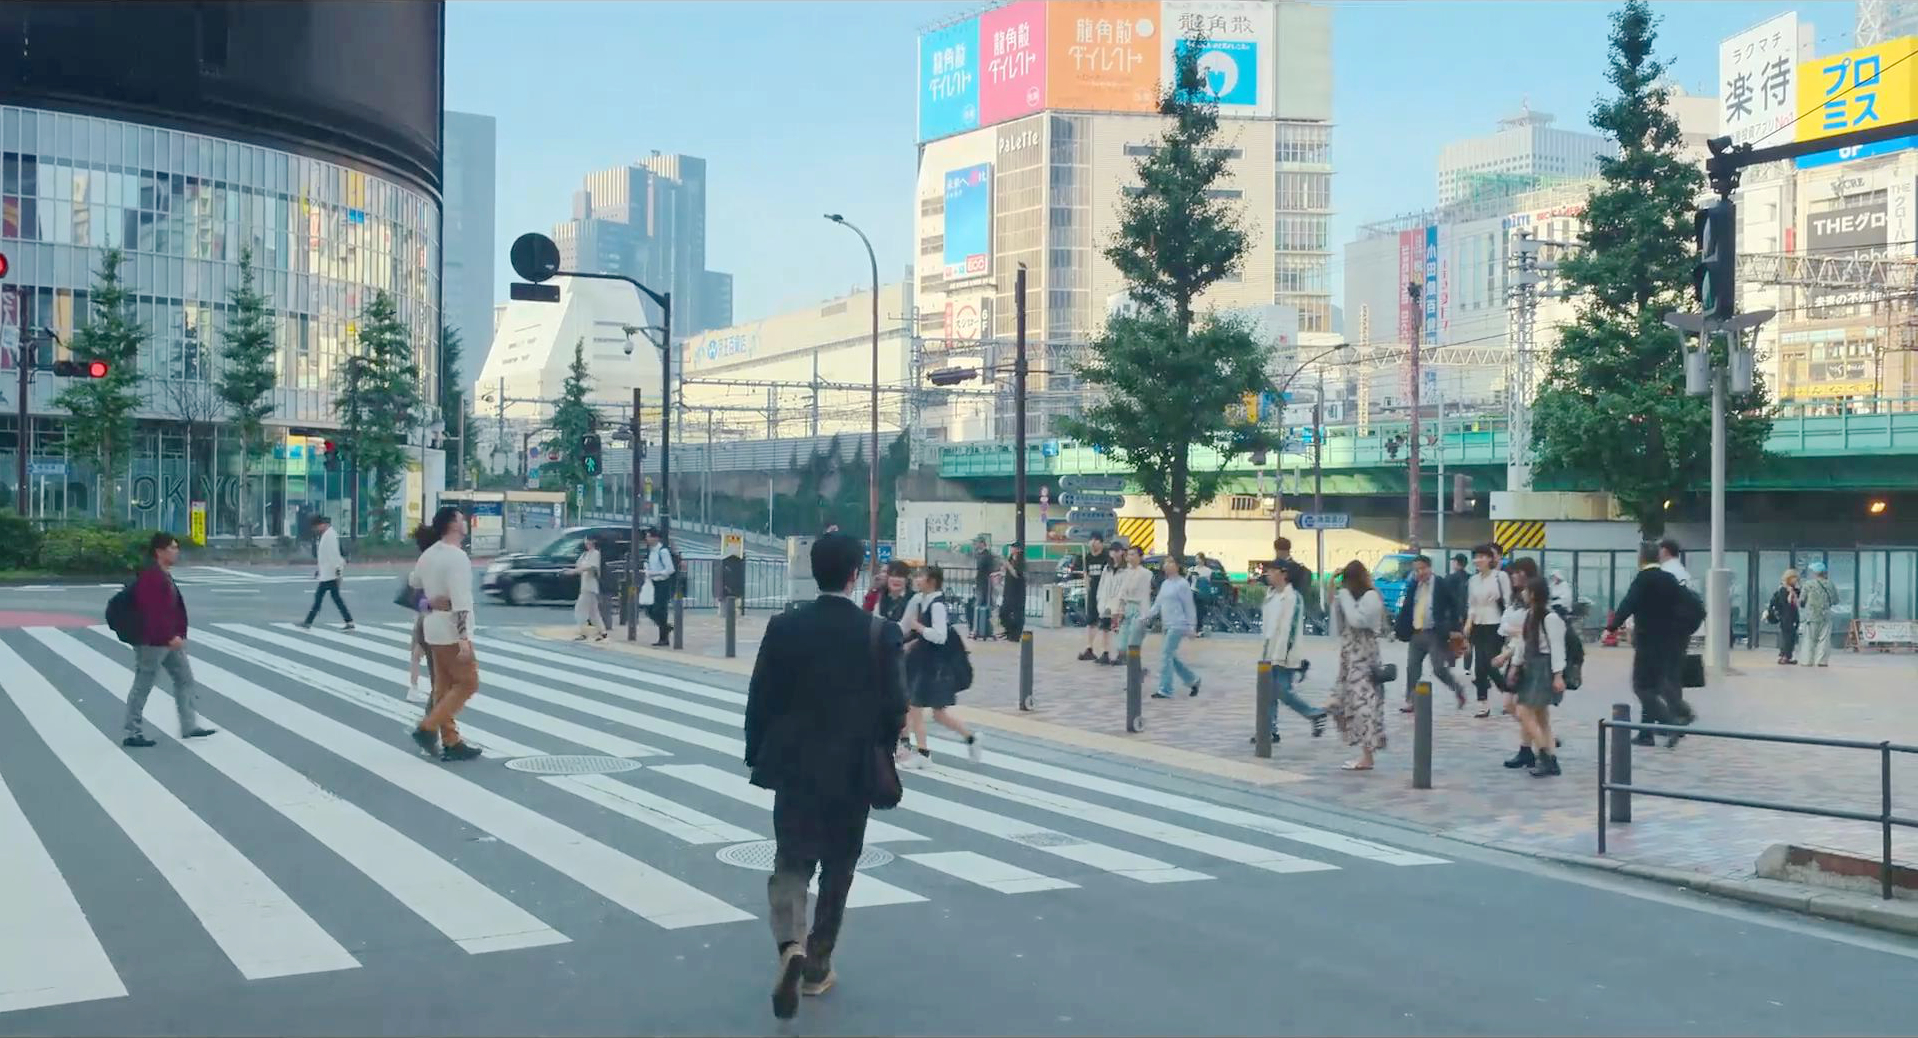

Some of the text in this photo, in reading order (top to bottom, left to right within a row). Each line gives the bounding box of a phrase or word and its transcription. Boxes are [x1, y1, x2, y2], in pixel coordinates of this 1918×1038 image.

[1068, 45, 1143, 73] ダイレクト
[1733, 31, 1782, 65] ラクマチ
[988, 50, 1036, 84] ダイレクト
[1725, 55, 1791, 124] 楽待
[1813, 212, 1888, 235] THEグロ
